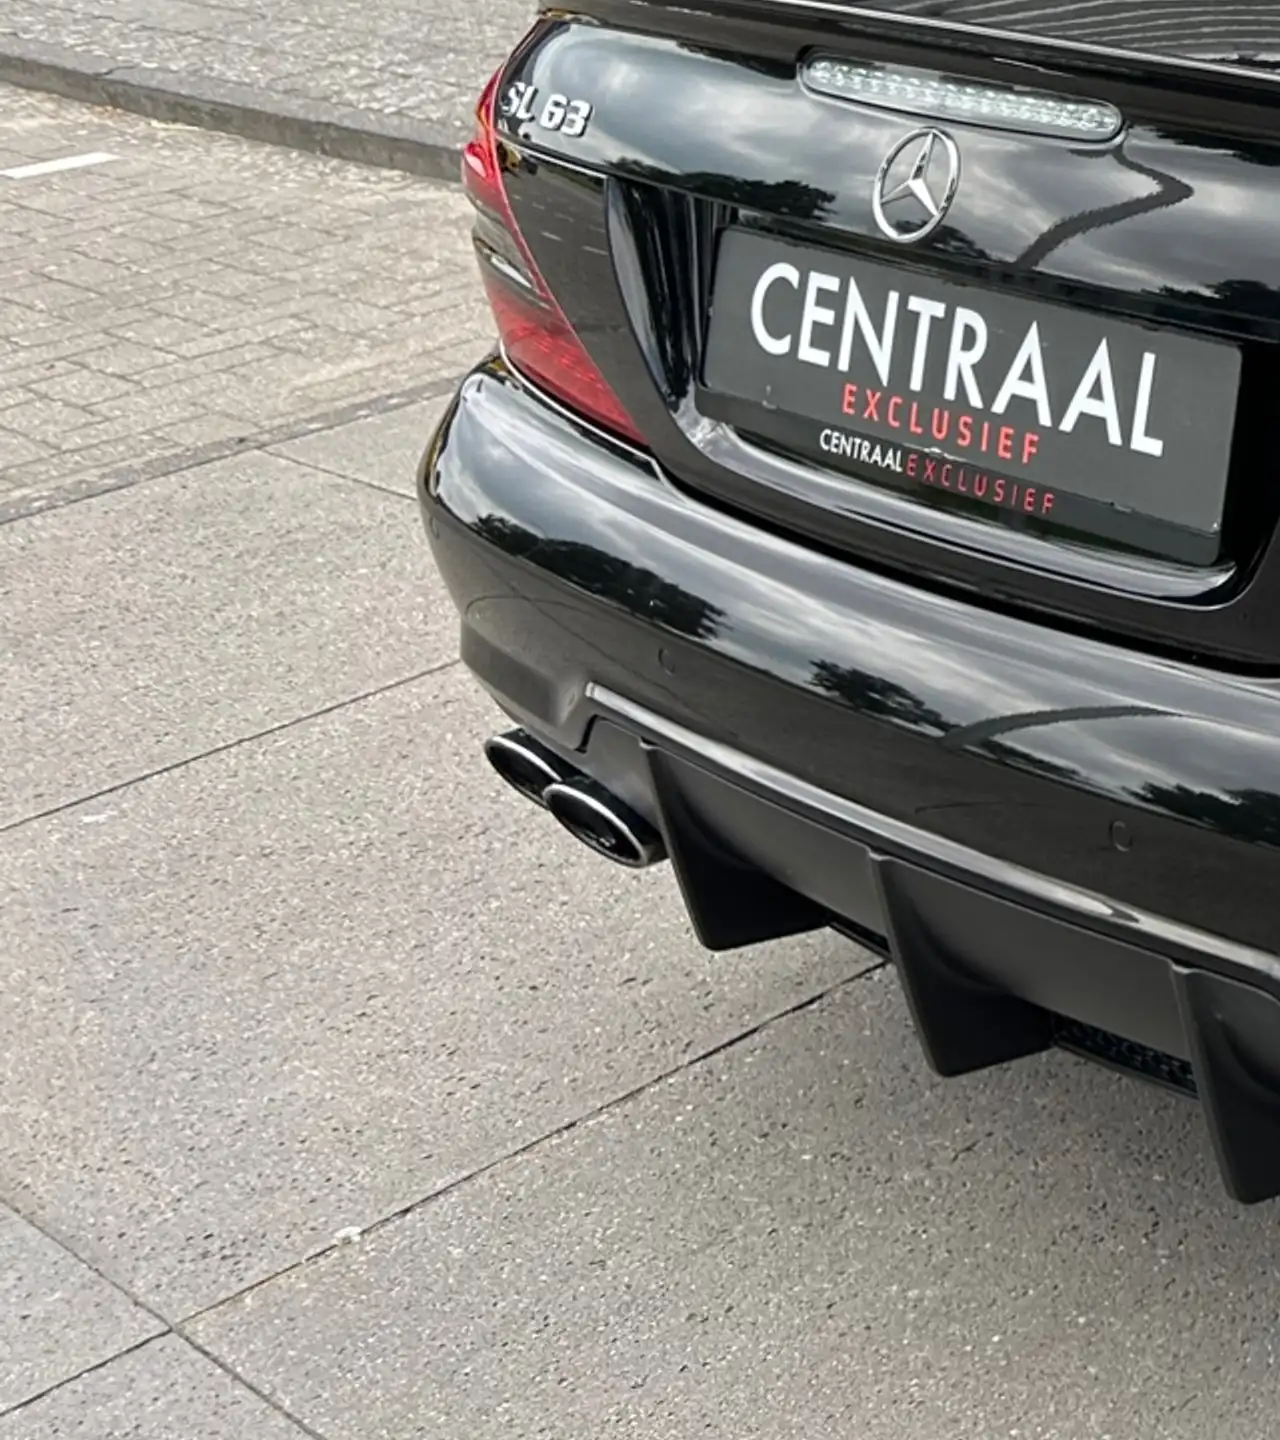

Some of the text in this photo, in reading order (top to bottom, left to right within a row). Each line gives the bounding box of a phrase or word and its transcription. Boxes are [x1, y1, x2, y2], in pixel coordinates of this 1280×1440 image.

[540, 93, 594, 137] 63
[750, 262, 1164, 458] CENTRAAL
[842, 383, 1041, 465] EXCLUSIEF
